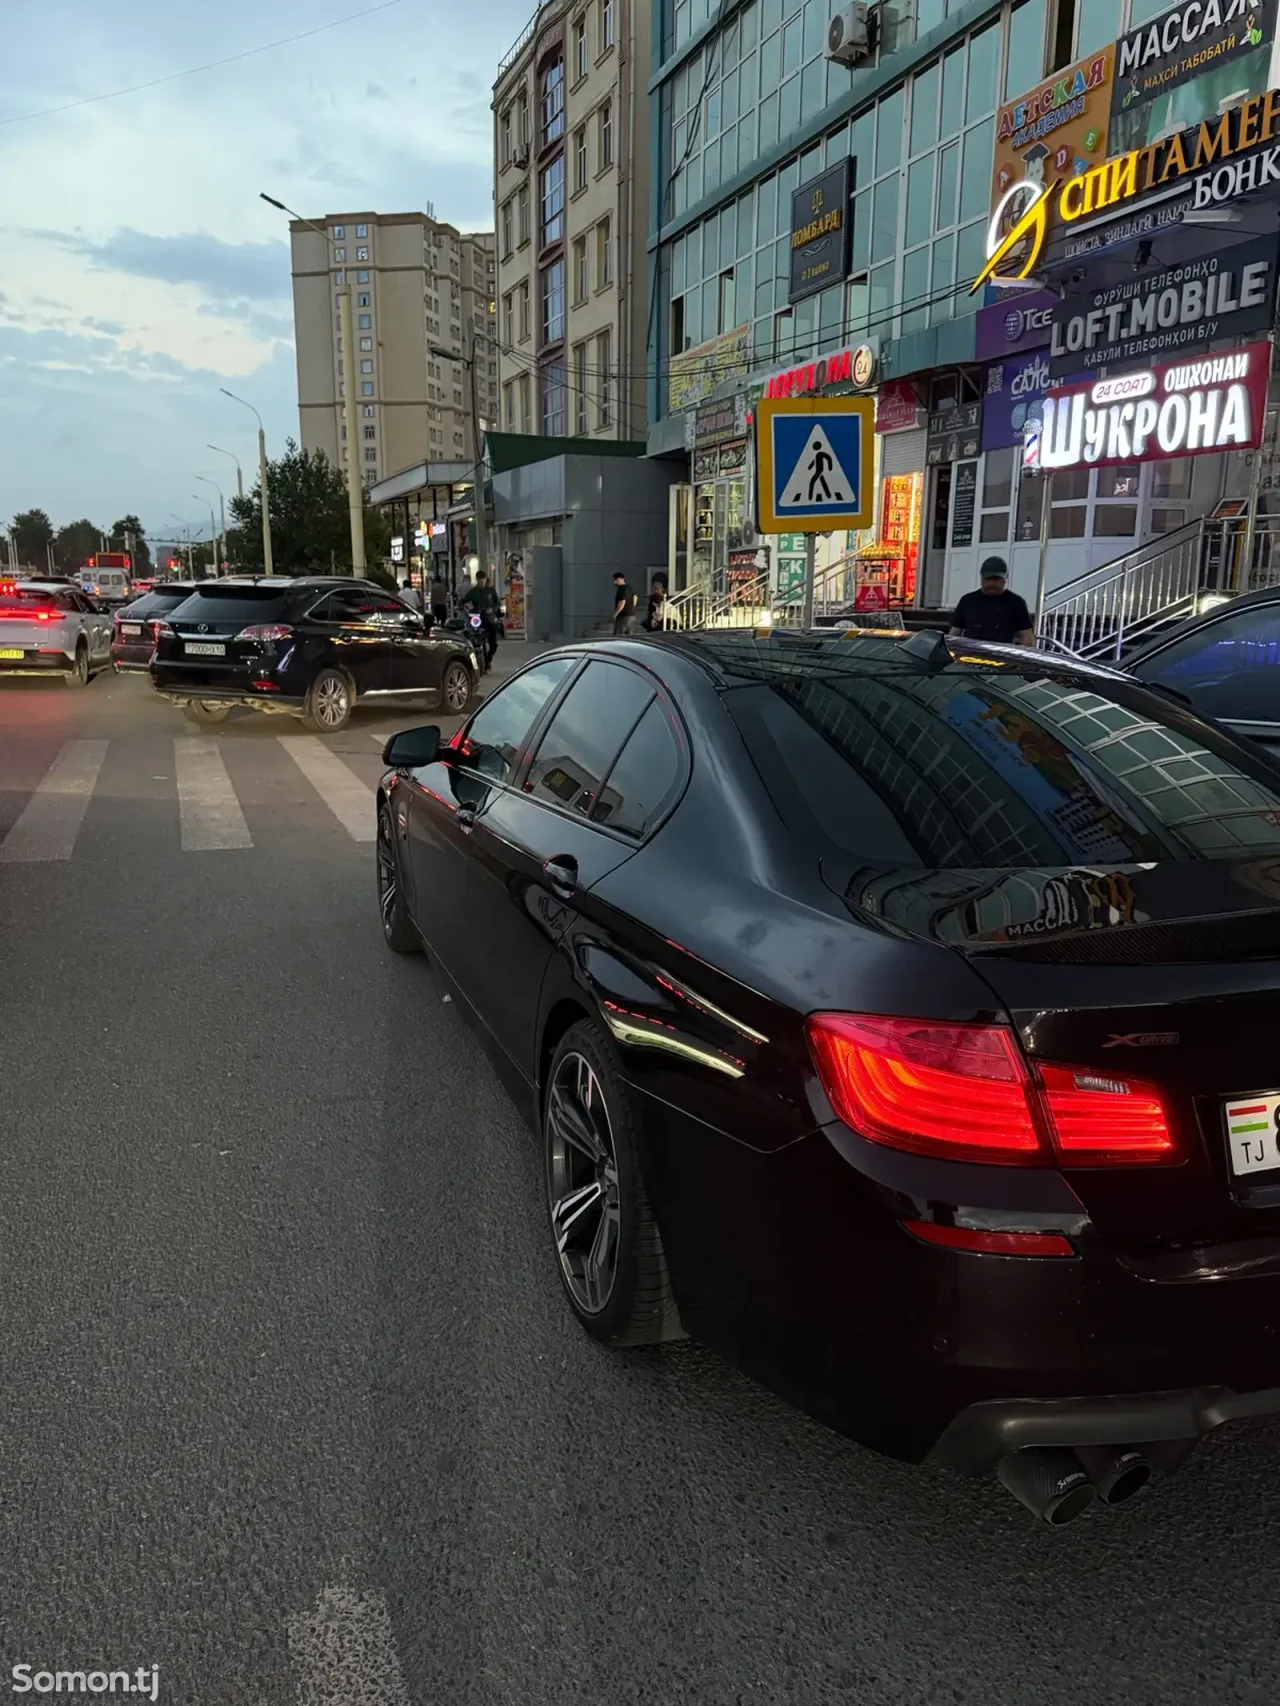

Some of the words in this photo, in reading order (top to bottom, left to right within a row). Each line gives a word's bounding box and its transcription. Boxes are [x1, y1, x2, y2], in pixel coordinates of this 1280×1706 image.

[997, 55, 1106, 143] ДЕТСКАЯ
[1011, 95, 1085, 149] АКАДЕМИЯ
[1050, 261, 1268, 357] LOFT.MOBILE
[1197, 321, 1218, 339] Б/У
[1096, 385, 1111, 399] 24
[1241, 1140, 1265, 1164] TJ
